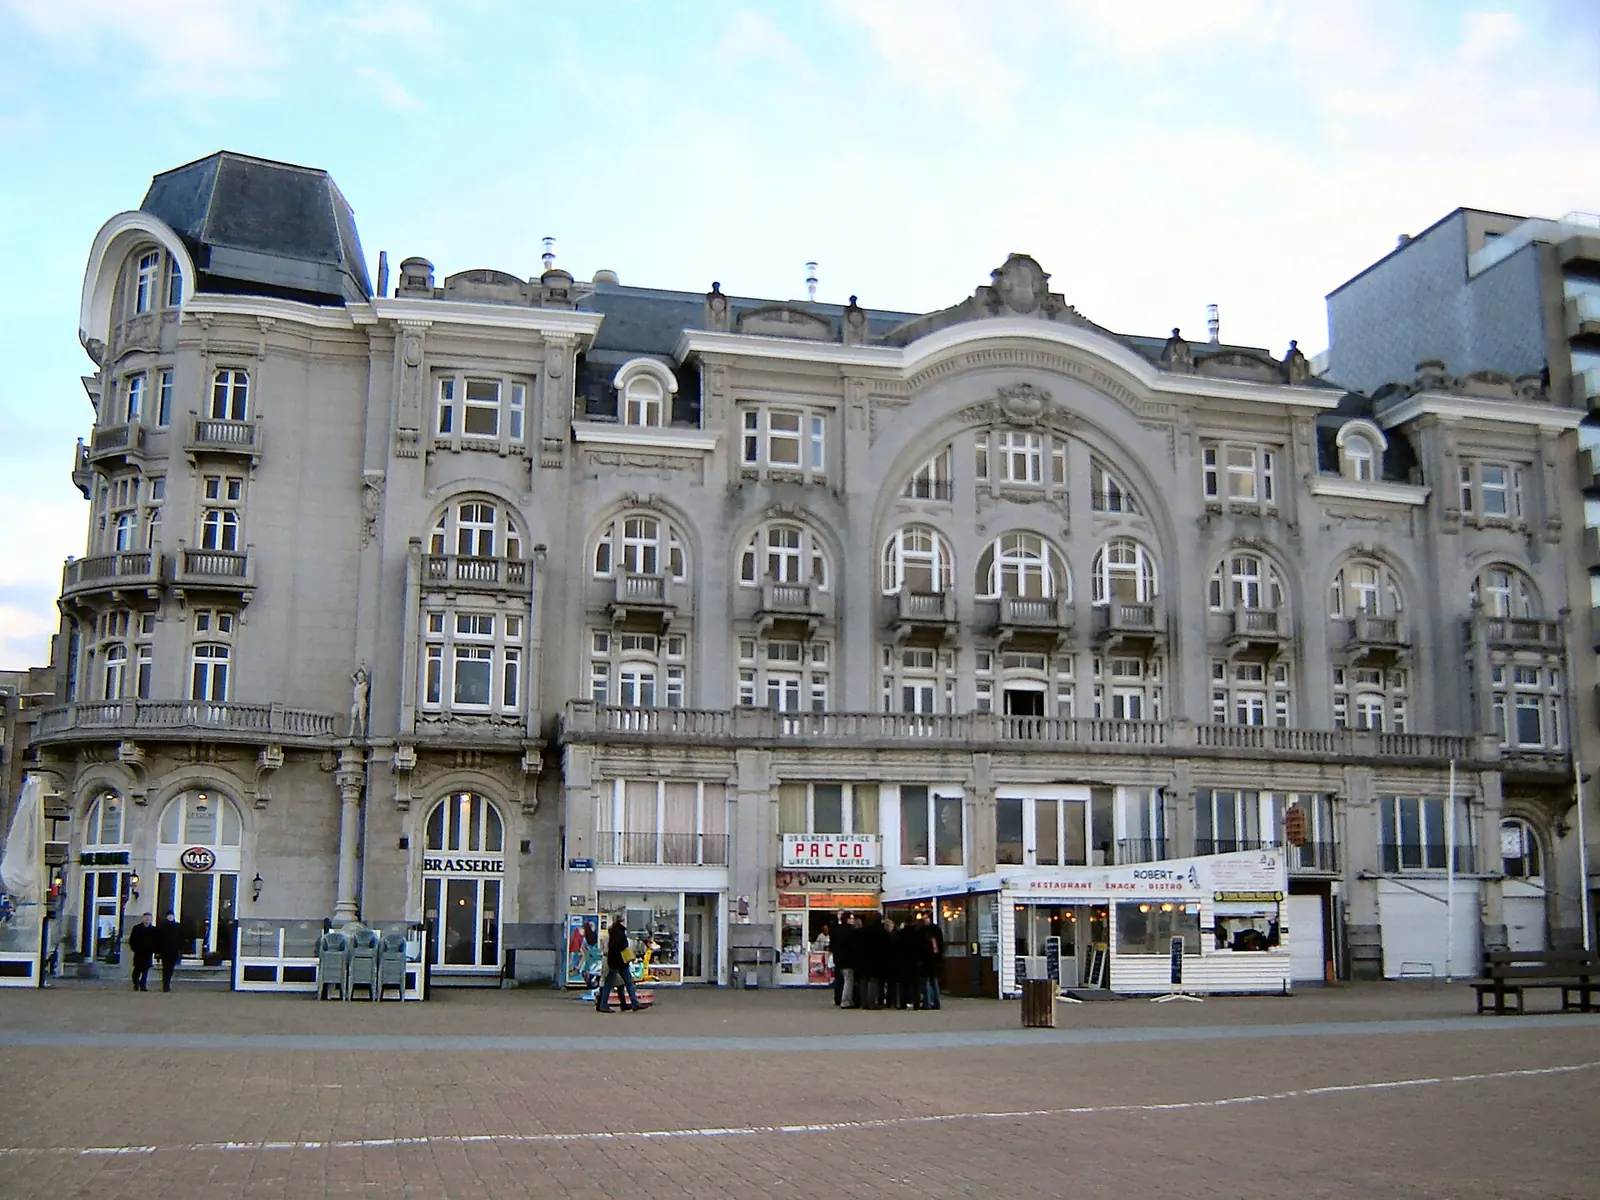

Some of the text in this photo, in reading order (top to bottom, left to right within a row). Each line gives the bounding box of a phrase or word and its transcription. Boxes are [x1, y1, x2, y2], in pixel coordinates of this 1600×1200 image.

[795, 843, 863, 858] PACCO
[185, 852, 213, 865] MAES
[788, 858, 870, 866] WAFELS GAUFRES
[423, 858, 505, 873] BRASSERIE
[808, 874, 878, 885] WAFELS PACCO
[1133, 870, 1174, 880] ROBERT
[1030, 882, 1183, 891] RESTAURANT SNACK BISTRO
